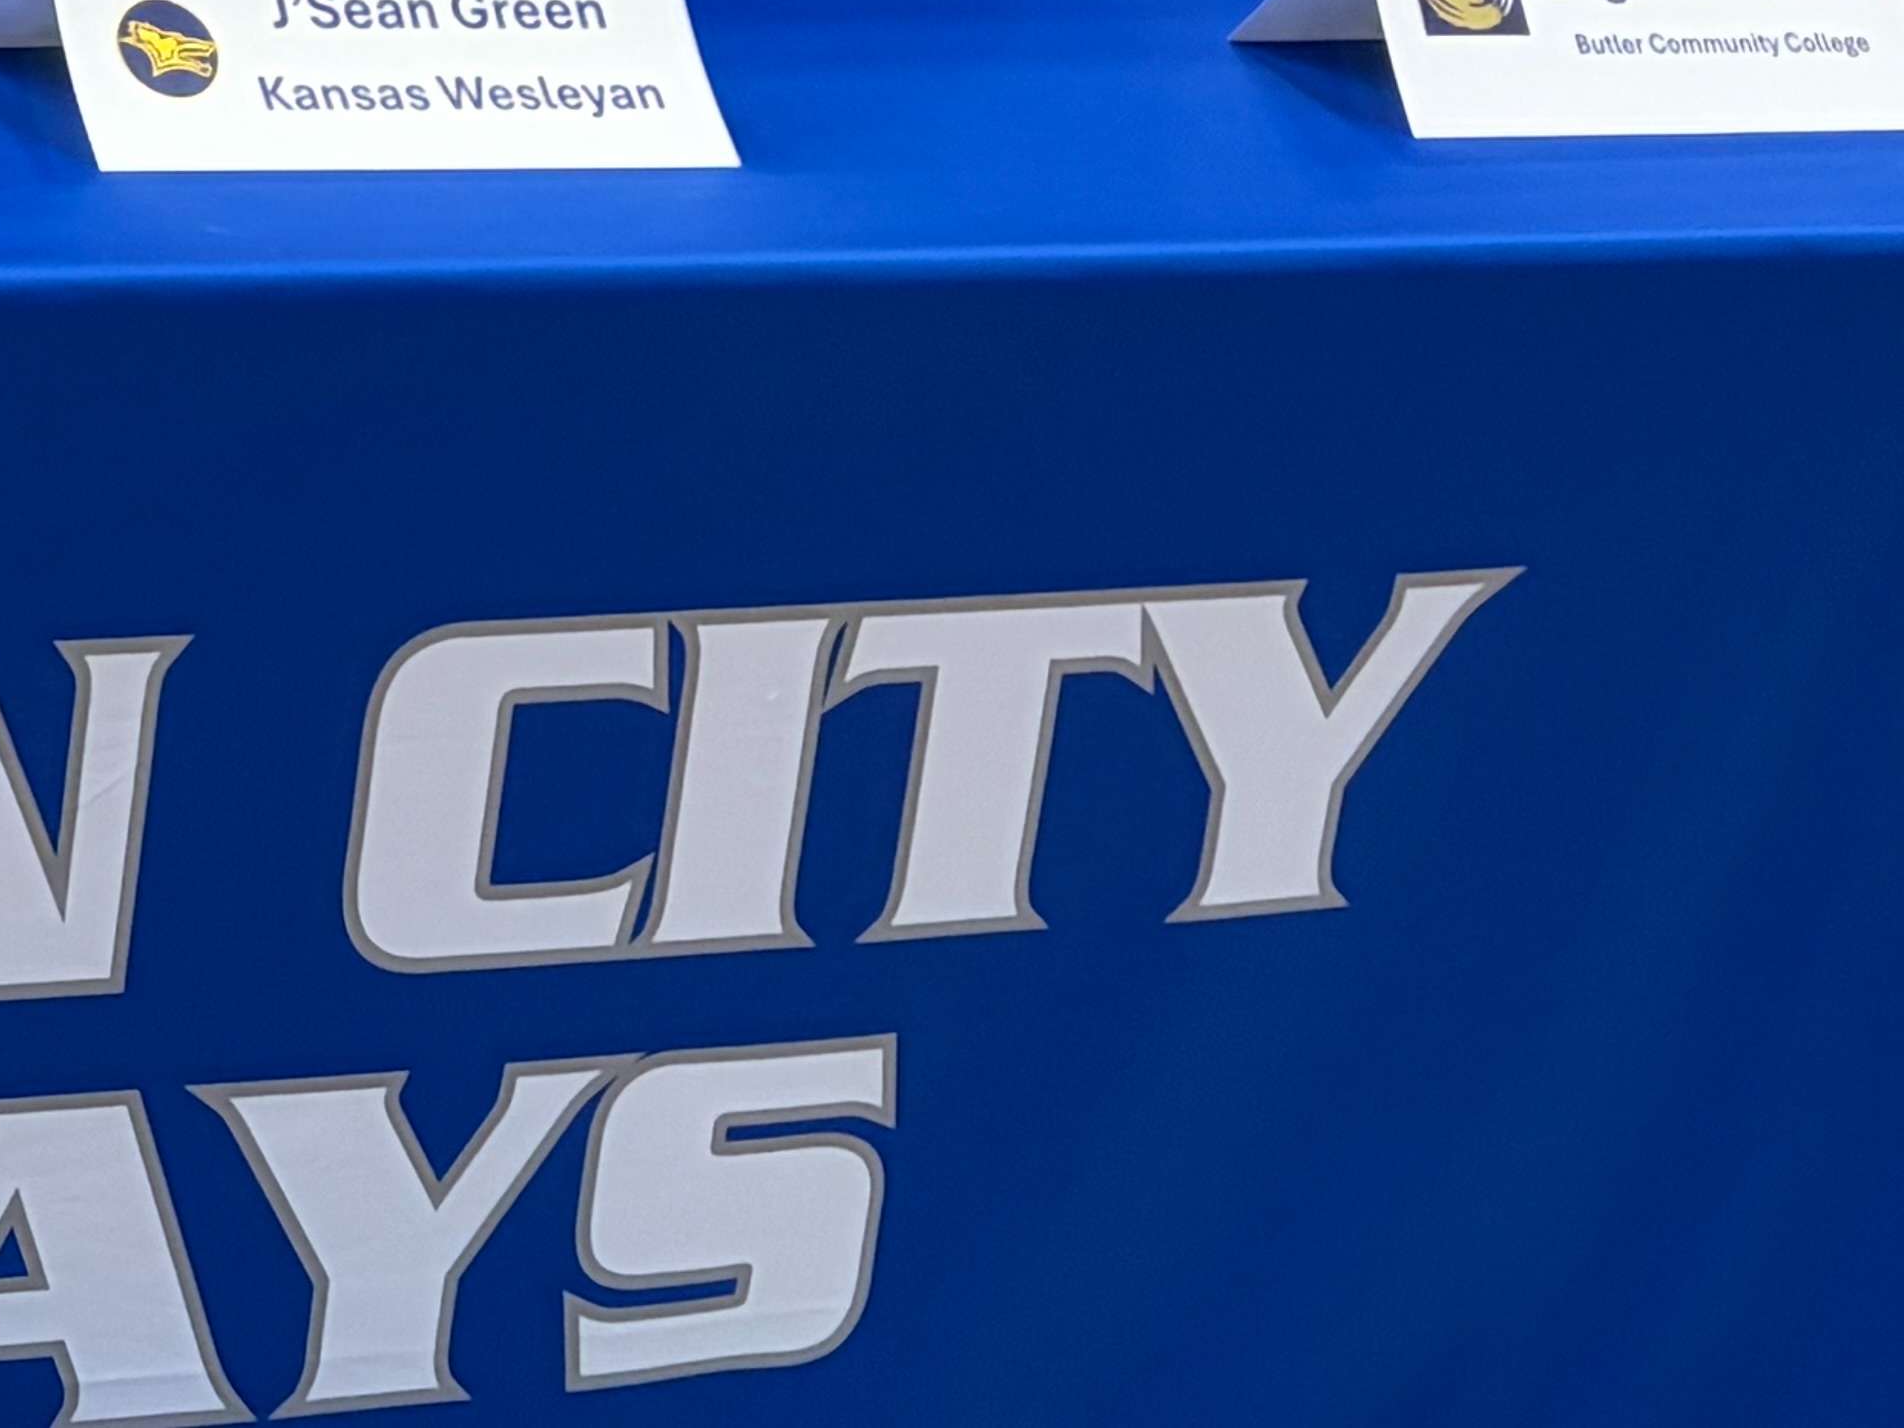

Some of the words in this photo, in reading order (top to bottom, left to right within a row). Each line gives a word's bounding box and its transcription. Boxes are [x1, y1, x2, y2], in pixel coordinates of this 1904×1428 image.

[1574, 32, 1644, 56] Butler
[1648, 32, 1780, 58] Community
[1784, 31, 1871, 58] College
[256, 75, 429, 111] Kansas
[436, 75, 666, 118] Wesleyan
[344, 565, 1527, 974] CITY
